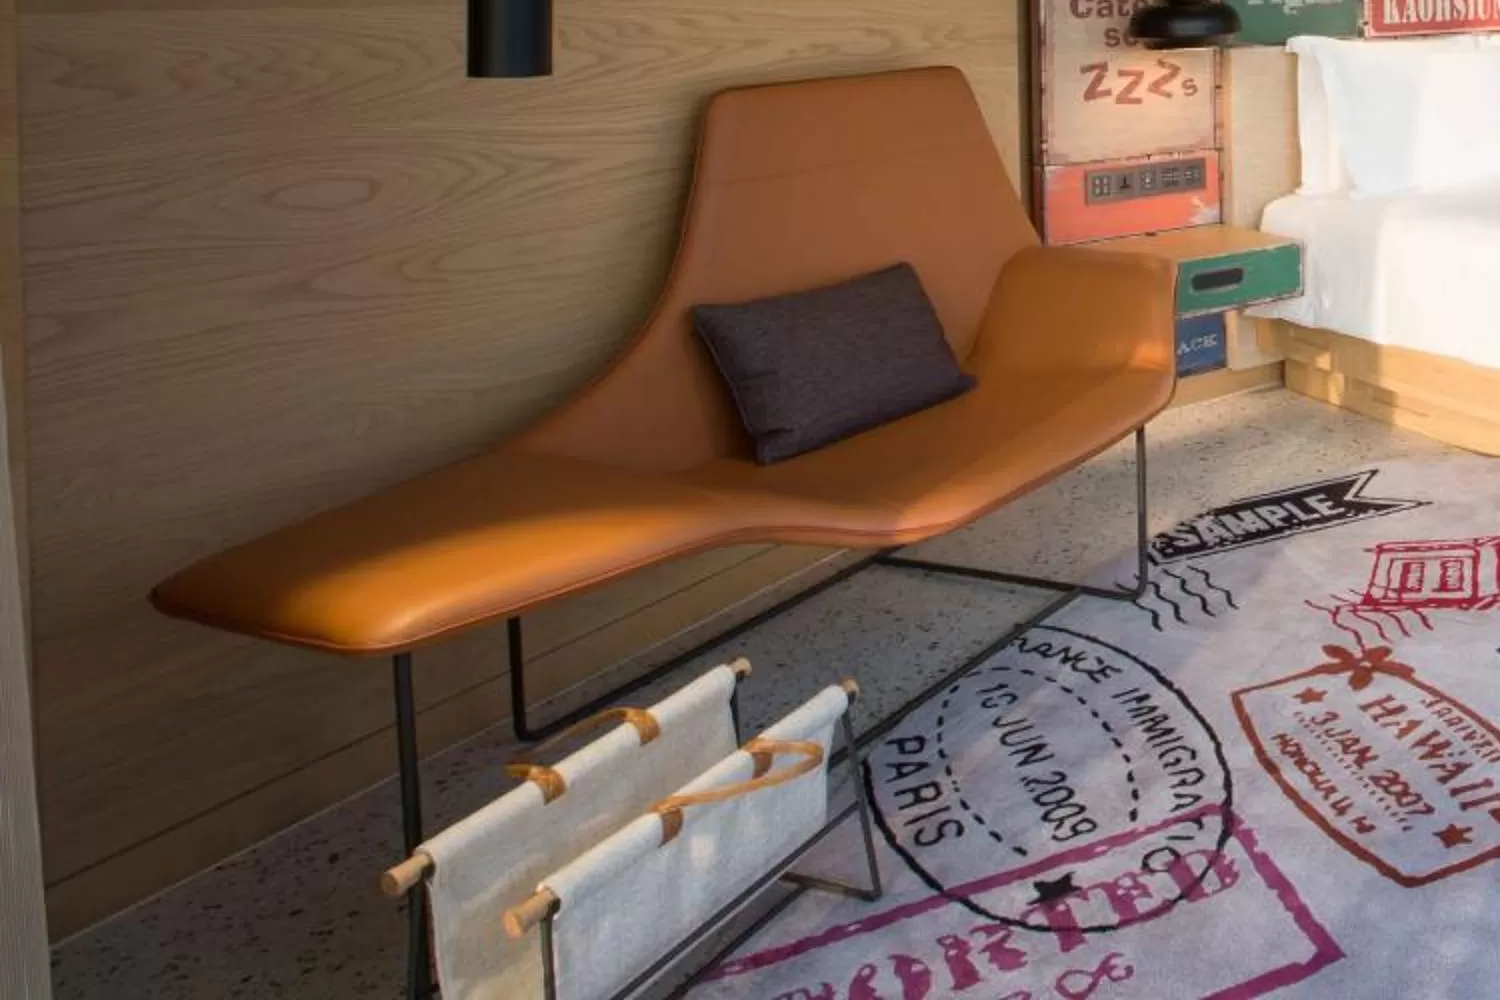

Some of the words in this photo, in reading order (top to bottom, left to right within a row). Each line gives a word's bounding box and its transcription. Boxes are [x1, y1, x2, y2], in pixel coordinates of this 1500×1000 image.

[1170, 492, 1346, 549] SAMPLE
[991, 716, 1056, 768] JUN
[1310, 711, 1342, 727] 3
[1324, 727, 1380, 770] JAN
[884, 734, 966, 848] PARIS
[1367, 768, 1437, 816] 2007
